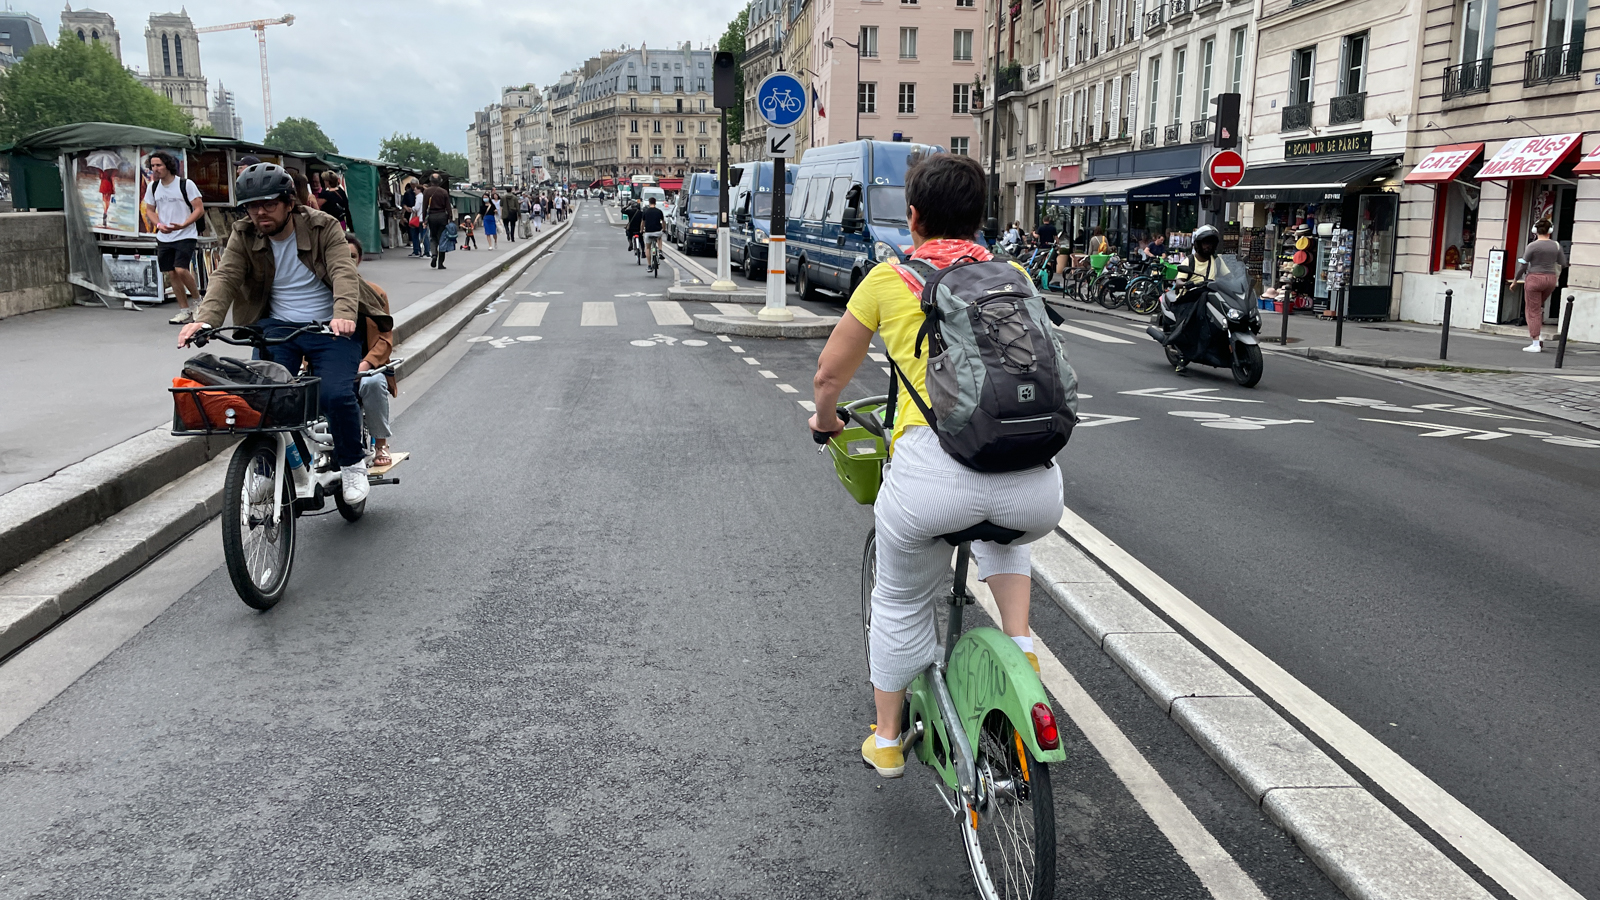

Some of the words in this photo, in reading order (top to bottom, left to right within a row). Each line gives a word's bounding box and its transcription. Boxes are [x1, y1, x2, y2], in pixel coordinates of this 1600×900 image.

[1327, 140, 1336, 152] DE
[1338, 137, 1360, 151] PARIS
[1521, 136, 1571, 157] RUSS
[1419, 150, 1470, 170] CAFÉ
[1480, 156, 1553, 175] MARKET
